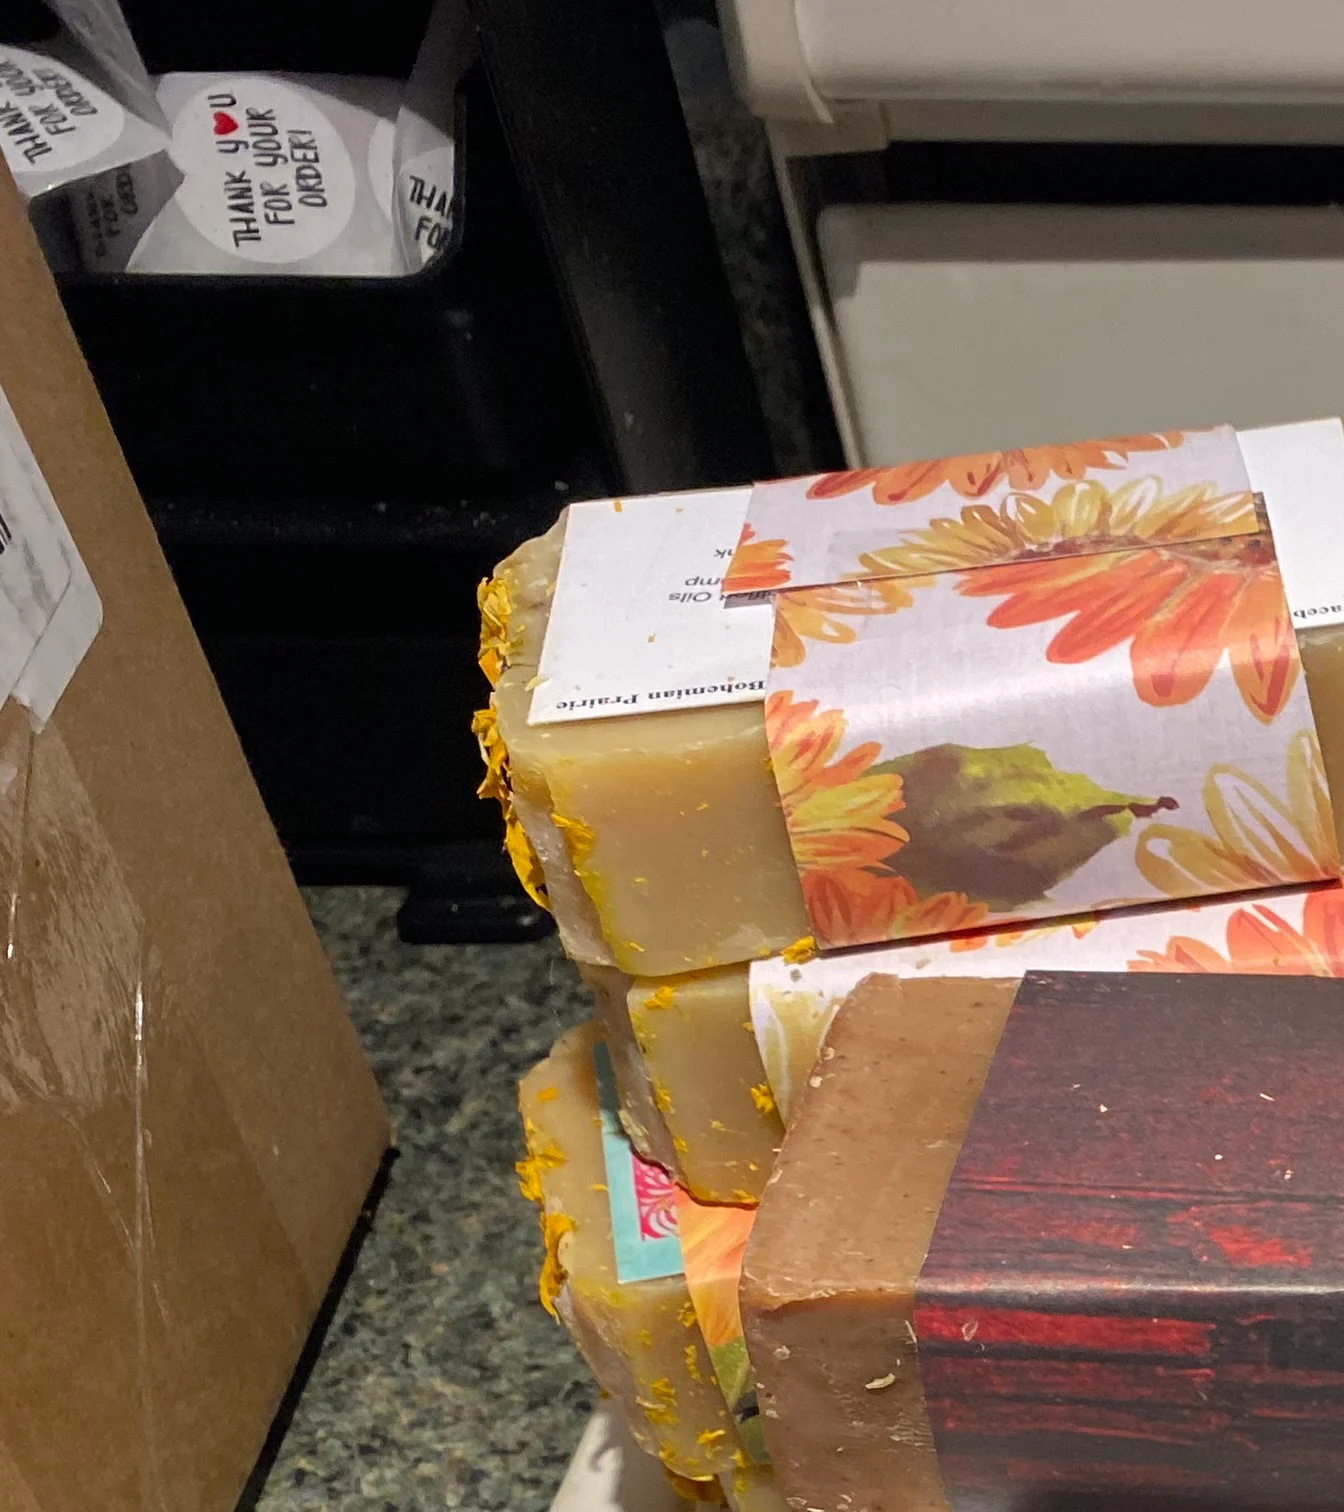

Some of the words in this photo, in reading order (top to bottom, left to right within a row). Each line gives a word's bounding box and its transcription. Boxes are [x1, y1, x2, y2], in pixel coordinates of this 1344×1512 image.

[246, 107, 288, 167] YOUR
[288, 129, 327, 208] ORDER!
[224, 170, 262, 247] THANK
[260, 183, 295, 225] FOR
[668, 591, 712, 603] Oils
[556, 693, 640, 712] Prairie
[649, 680, 765, 701] Bohemian
